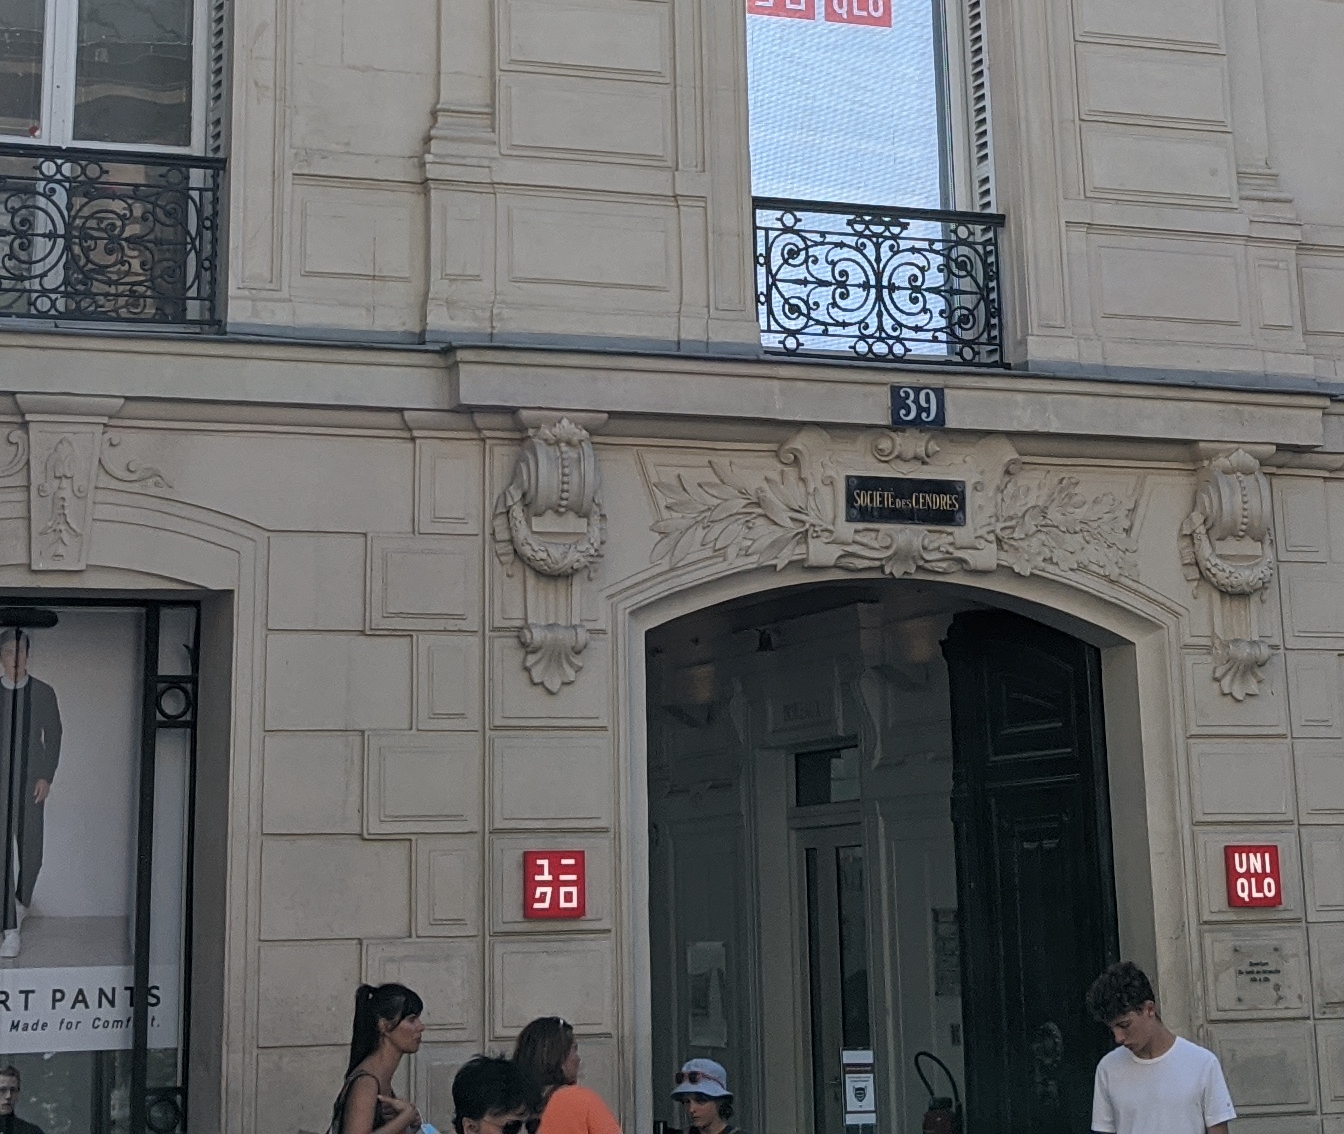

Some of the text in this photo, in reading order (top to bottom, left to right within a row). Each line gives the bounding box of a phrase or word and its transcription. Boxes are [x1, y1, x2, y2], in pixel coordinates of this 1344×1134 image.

[899, 387, 937, 422] 39
[912, 492, 959, 511] CENDRES
[1233, 852, 1271, 874] UNI
[1236, 877, 1276, 902] QLO
[50, 985, 162, 1011] PANTS
[9, 1018, 49, 1033] Made
[58, 1017, 82, 1032] for
